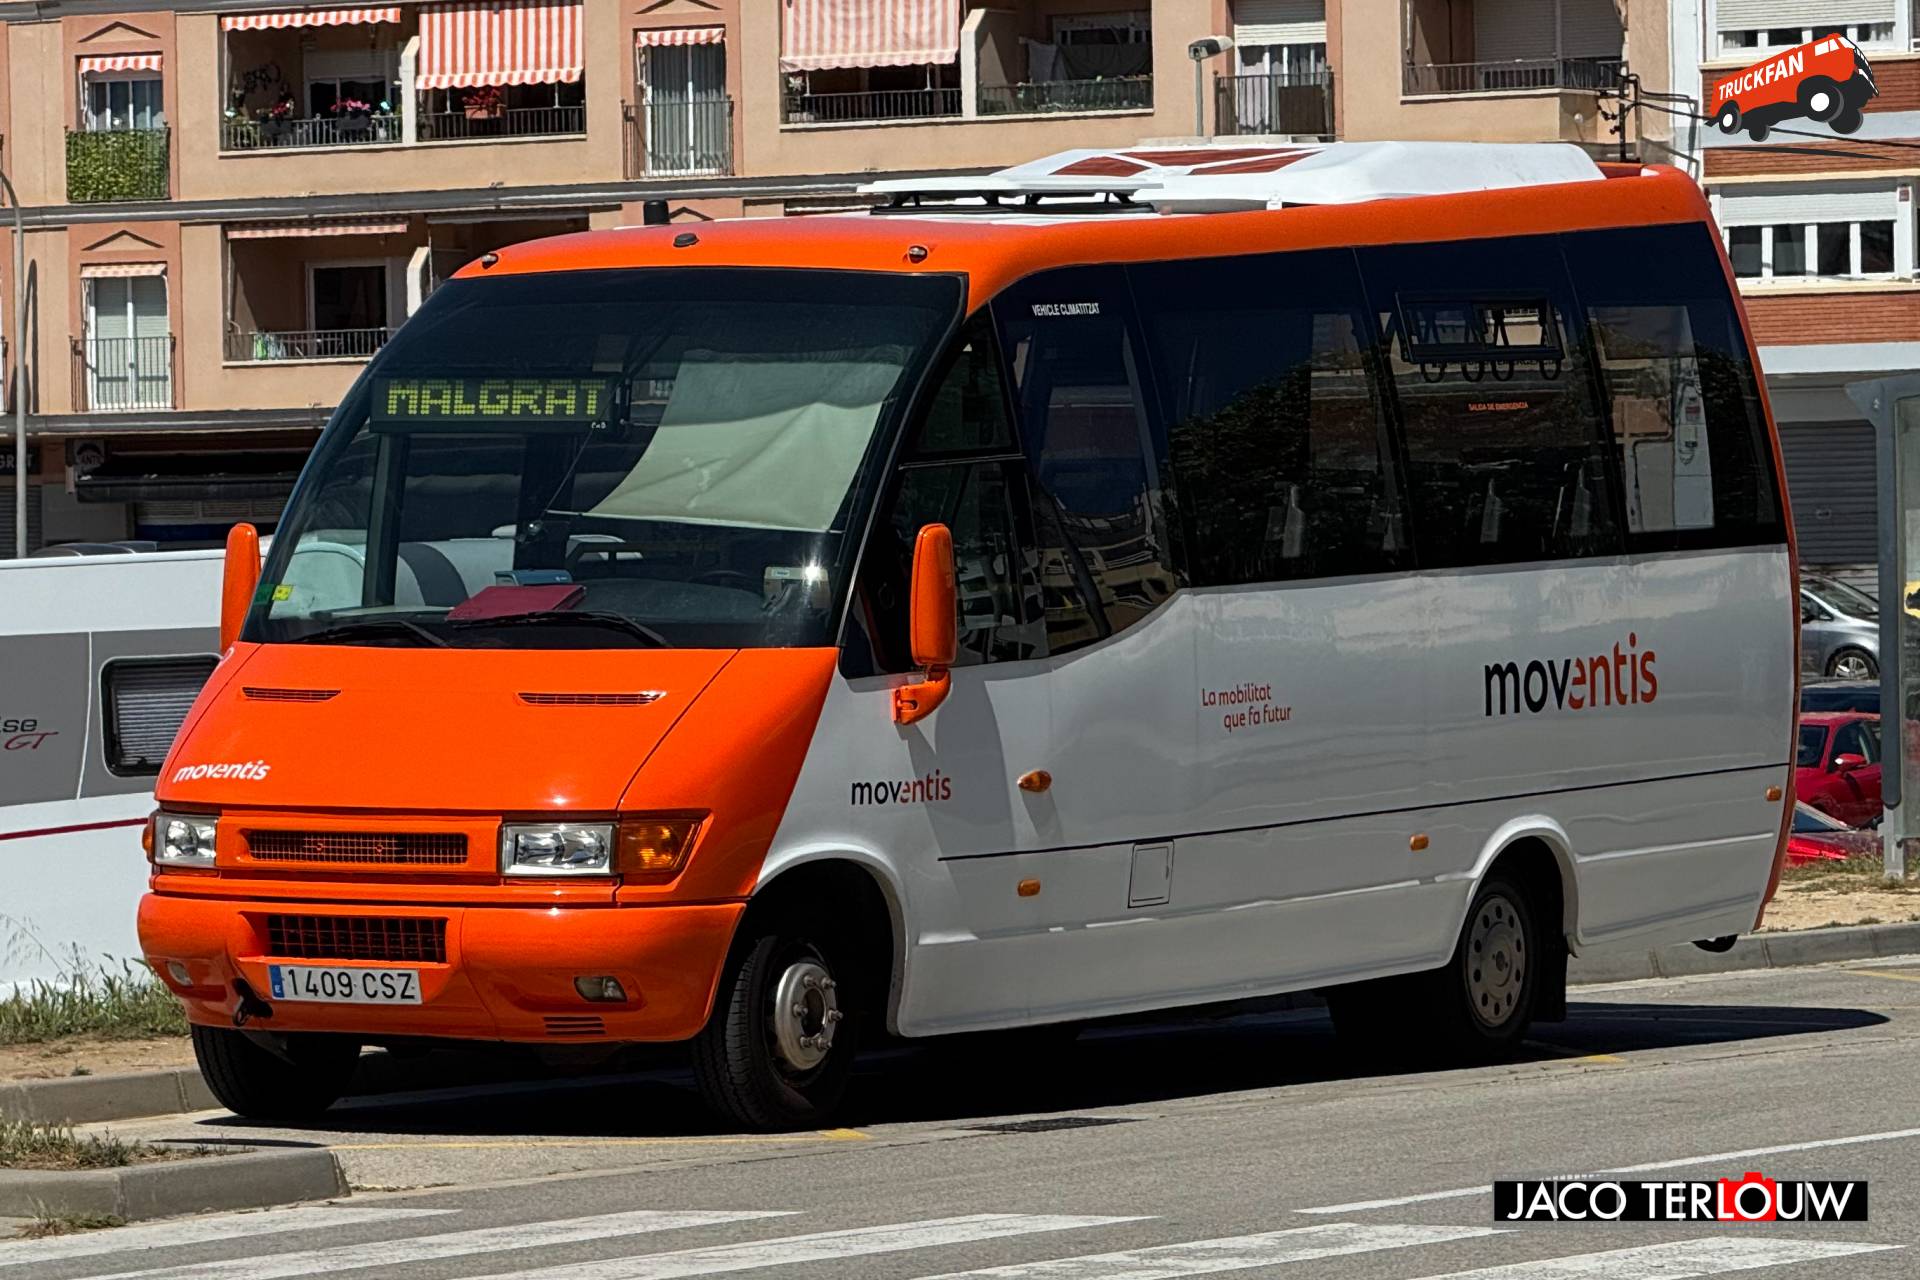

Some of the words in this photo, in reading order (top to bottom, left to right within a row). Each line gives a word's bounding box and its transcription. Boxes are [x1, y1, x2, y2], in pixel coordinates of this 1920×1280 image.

[1032, 303, 1060, 316] VEHICLE
[387, 379, 607, 415] MALGRAT
[1484, 631, 1658, 716] moventis
[1202, 687, 1216, 706] La
[1219, 682, 1271, 706] mobilitat
[0, 716, 38, 733] se
[1224, 711, 1246, 733] que
[1248, 705, 1261, 725] fa
[1263, 703, 1291, 724] futur
[4, 731, 60, 750] GT
[172, 759, 271, 784] moventis
[851, 768, 951, 805] moventis
[288, 968, 353, 998] 1409
[362, 972, 416, 999] CSZ
